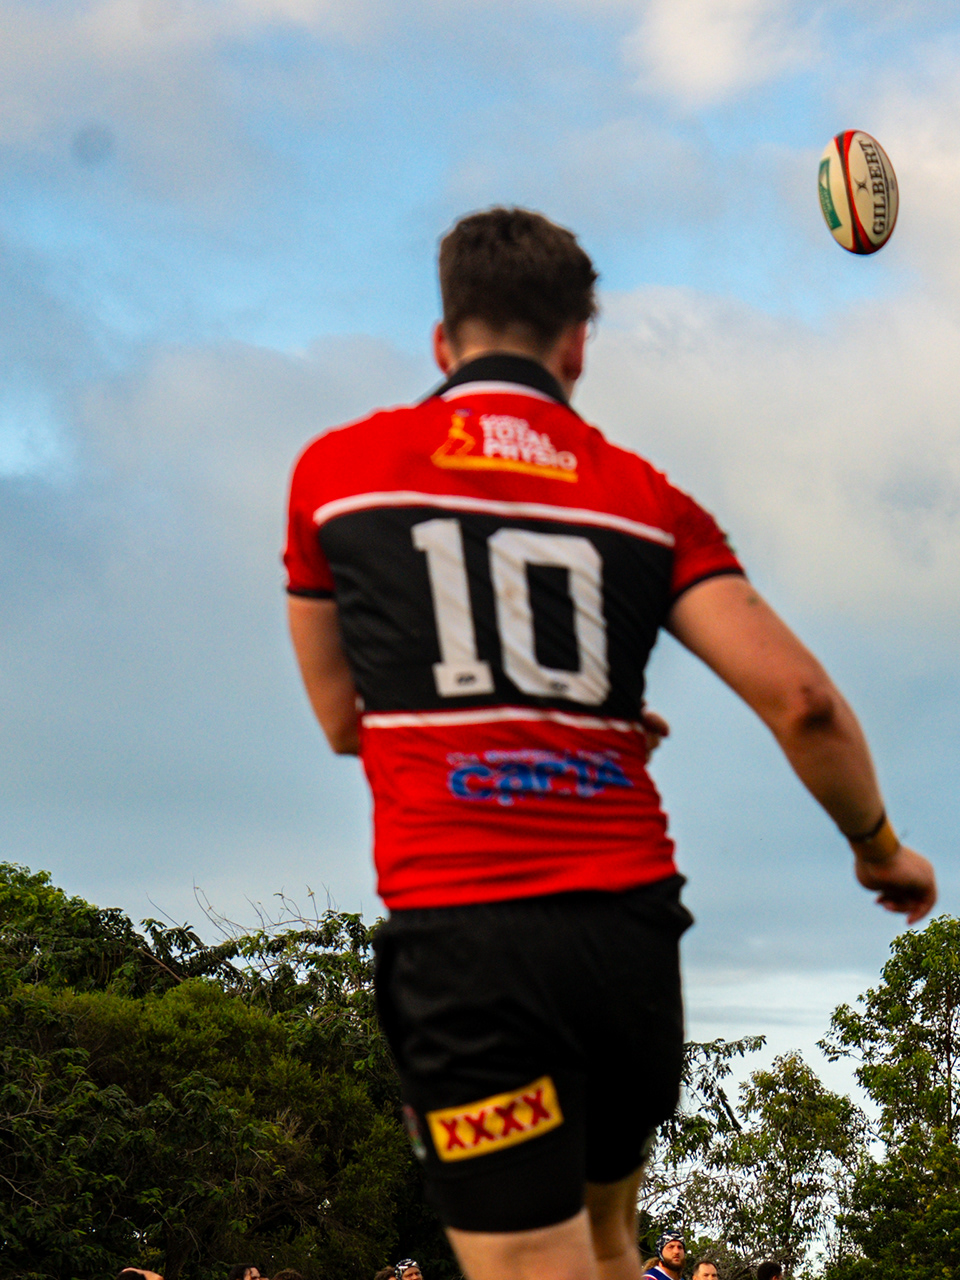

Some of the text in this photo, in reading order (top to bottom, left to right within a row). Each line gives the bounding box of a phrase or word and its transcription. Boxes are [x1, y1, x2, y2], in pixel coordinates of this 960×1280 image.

[858, 139, 886, 235] GILBERT
[482, 437, 578, 471] PHYSIO
[411, 518, 611, 707] 10
[438, 1087, 552, 1152] XXXX
